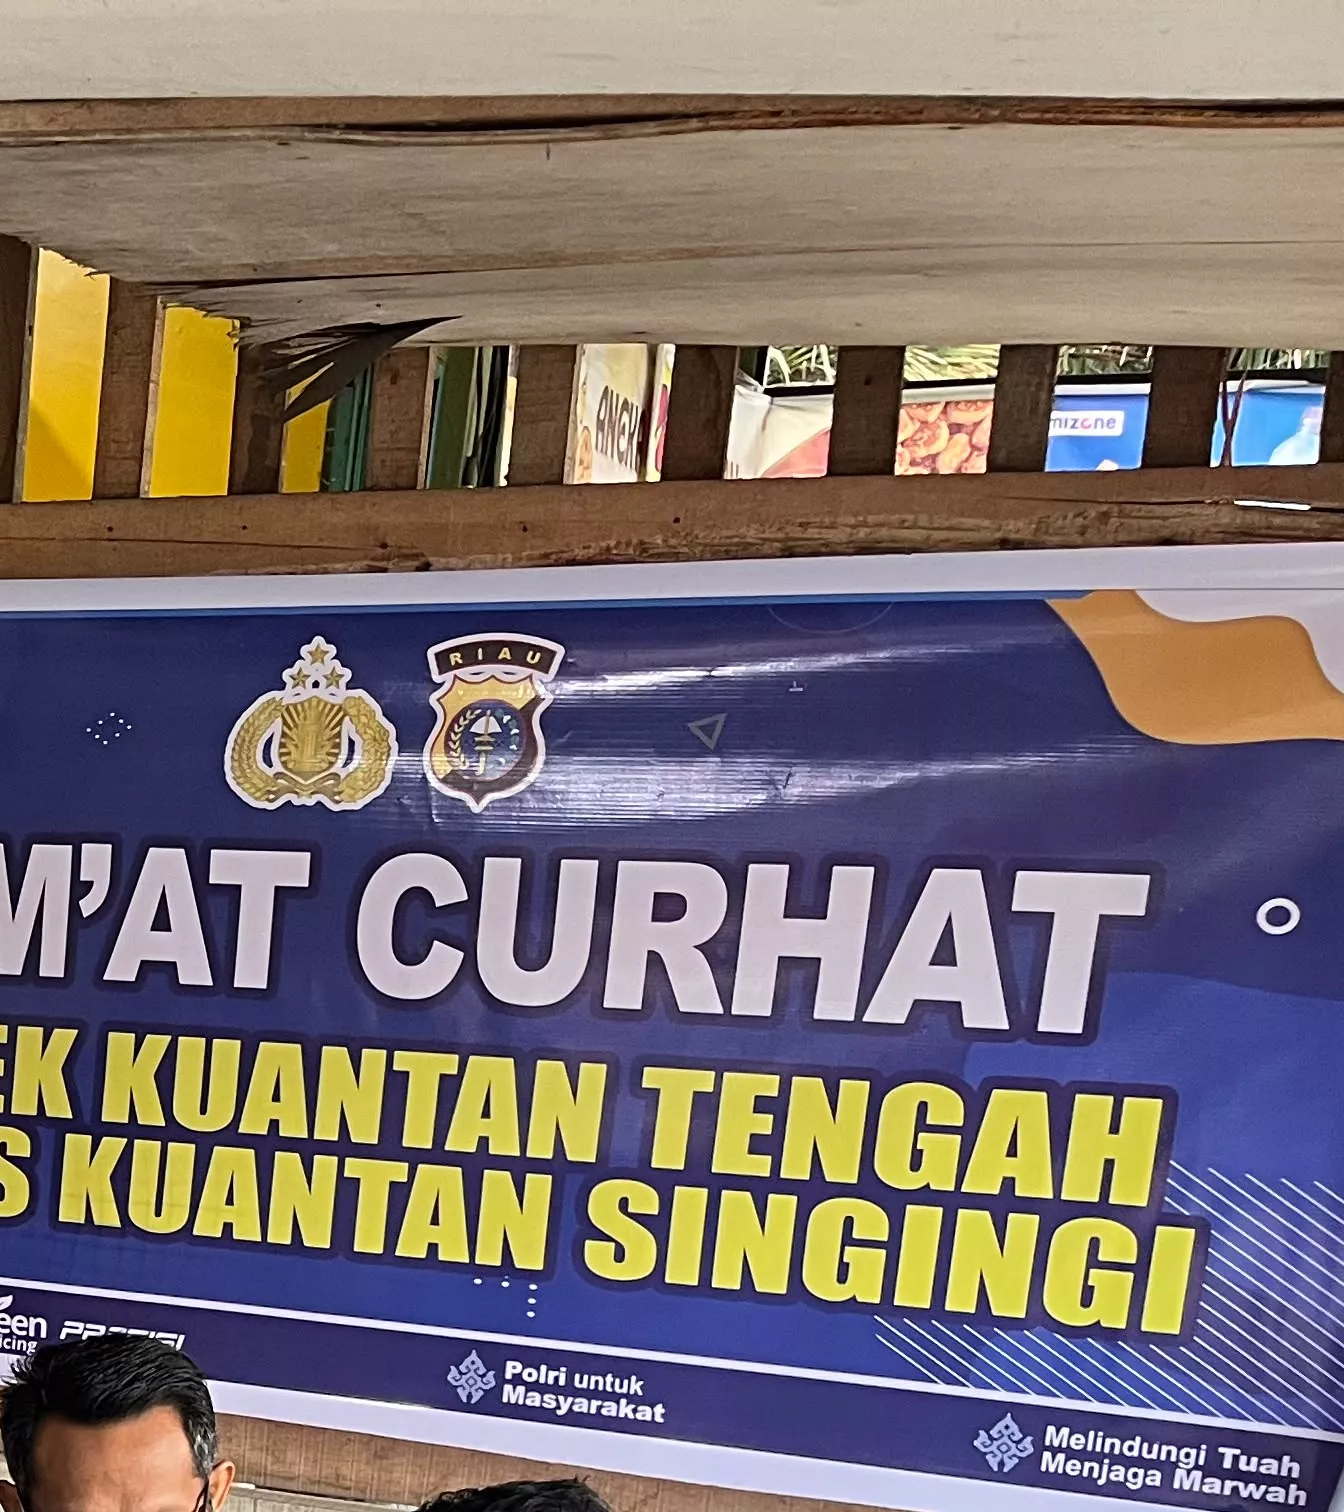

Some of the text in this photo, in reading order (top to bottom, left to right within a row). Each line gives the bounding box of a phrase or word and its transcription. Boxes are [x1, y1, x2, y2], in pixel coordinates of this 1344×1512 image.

[449, 647, 542, 666] RIAU
[356, 852, 1152, 1036] CURHAT
[100, 1032, 609, 1164] KUANTAN
[640, 1066, 1164, 1209] TENGAH
[58, 1133, 553, 1271] KUANTAN
[584, 1178, 1197, 1337] SINGINGI
[502, 1384, 666, 1423] Masyarakat
[504, 1360, 645, 1396] Polri untuk
[1040, 1452, 1308, 1506] Menjaga Marwah
[1044, 1425, 1301, 1479] Melindungi Tuah
